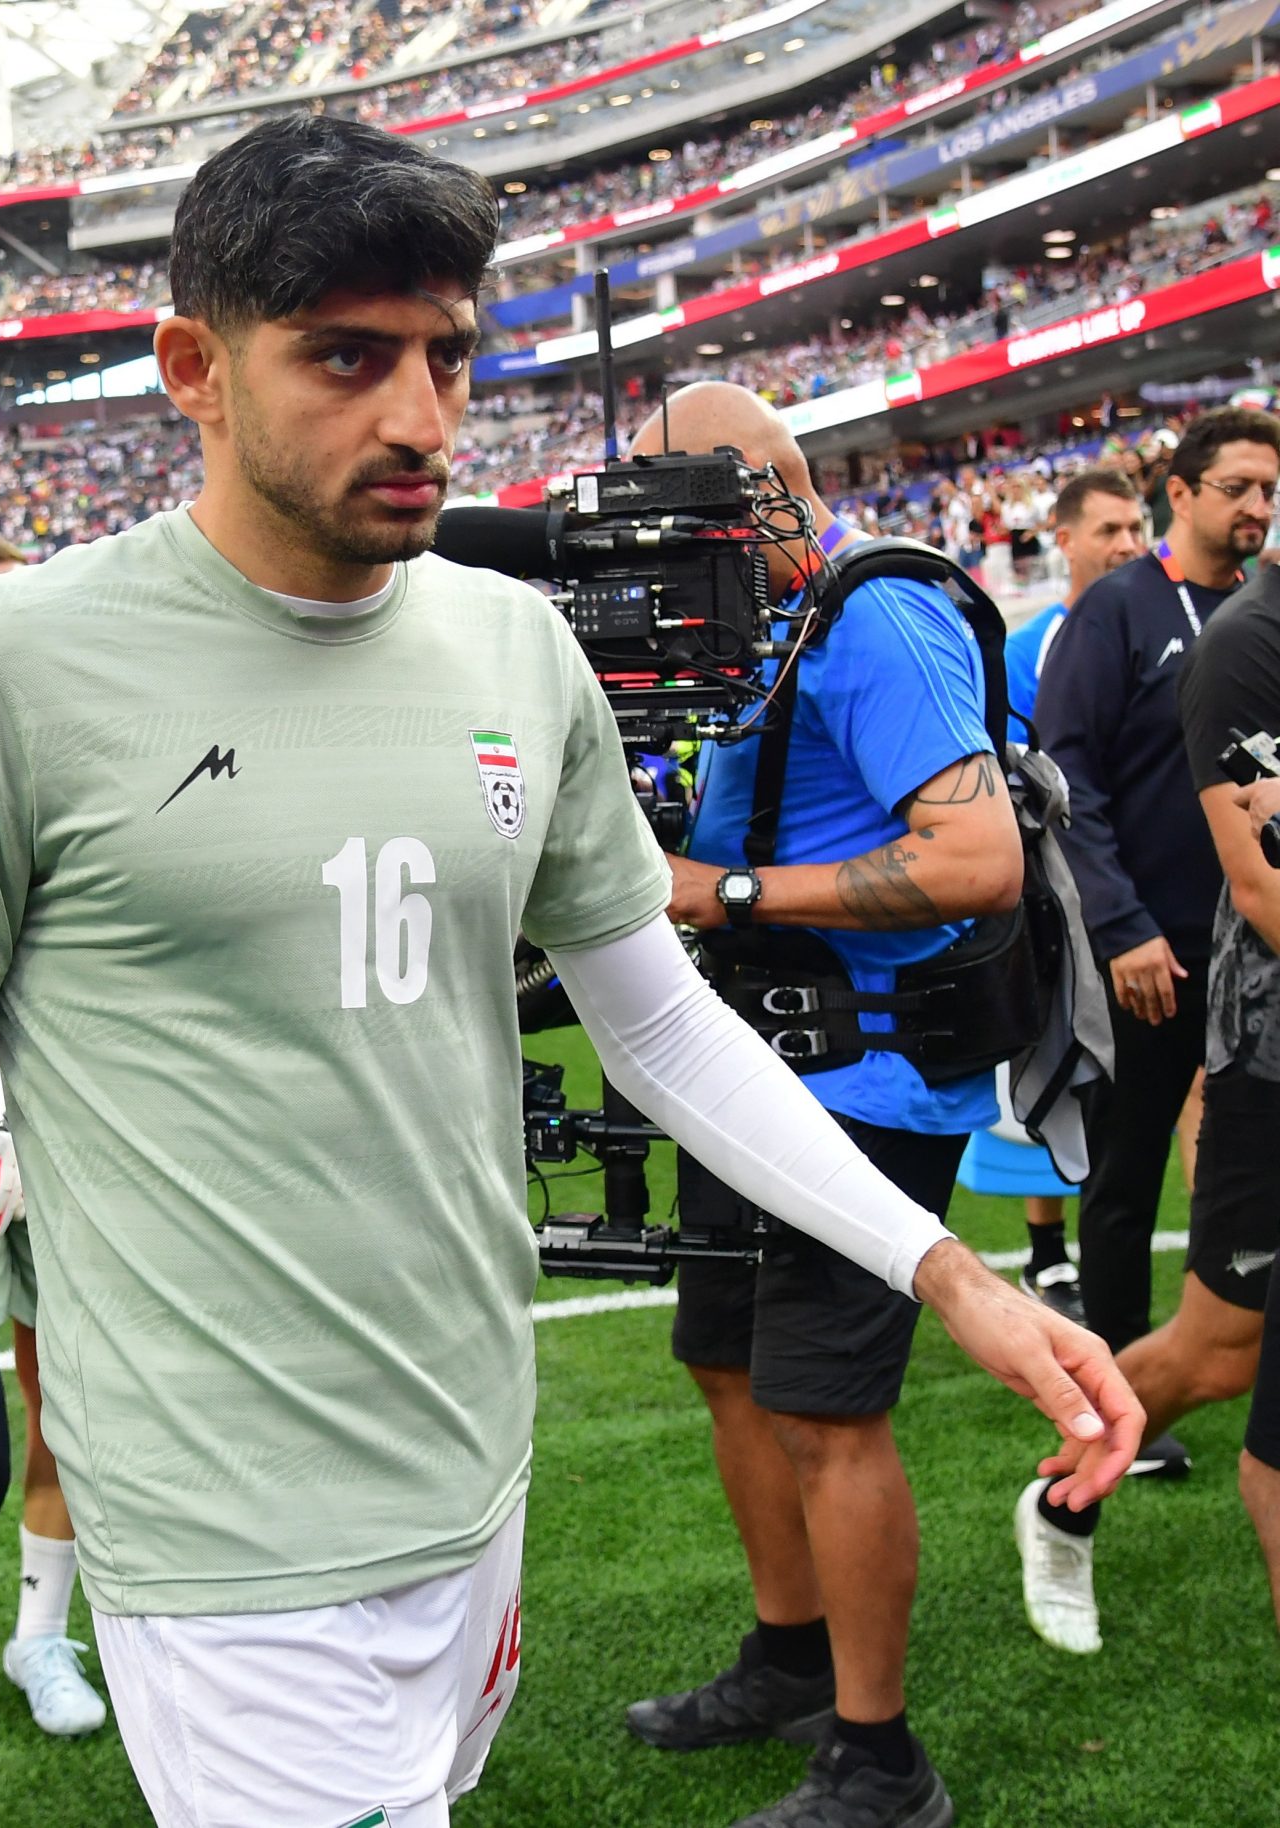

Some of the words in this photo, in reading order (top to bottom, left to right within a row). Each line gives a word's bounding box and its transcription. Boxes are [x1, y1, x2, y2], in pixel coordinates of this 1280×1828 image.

[938, 126, 985, 164] LOS
[987, 77, 1098, 145] ANGELES
[321, 836, 437, 1009] 16
